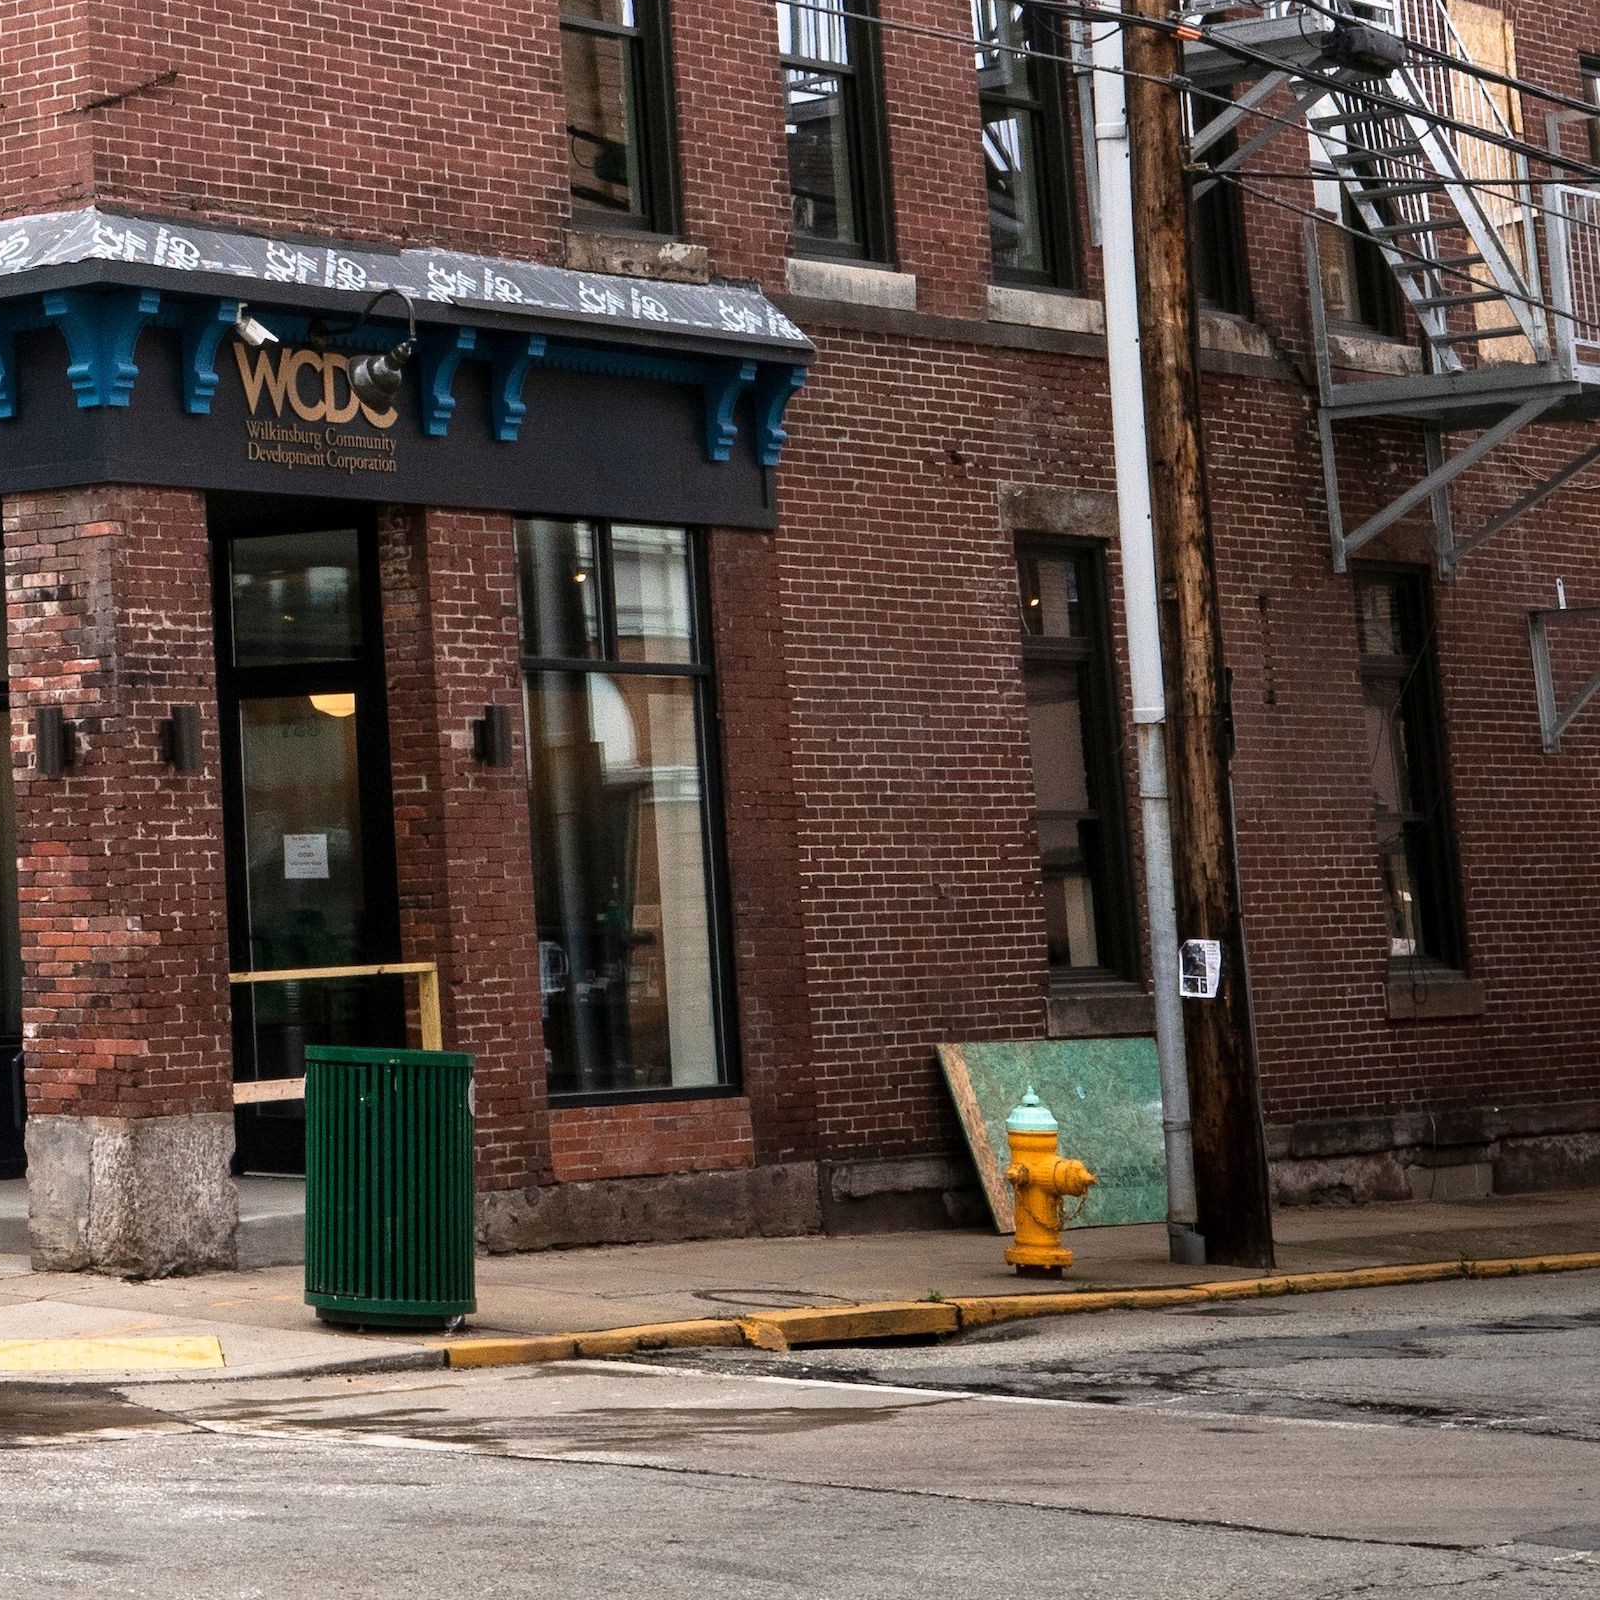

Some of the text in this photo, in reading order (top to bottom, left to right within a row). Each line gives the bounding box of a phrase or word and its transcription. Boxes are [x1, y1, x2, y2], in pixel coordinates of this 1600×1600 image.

[233, 342, 398, 429] WCD
[246, 420, 396, 456] Wilkinsburg Community
[248, 441, 397, 475] Development Corporation
